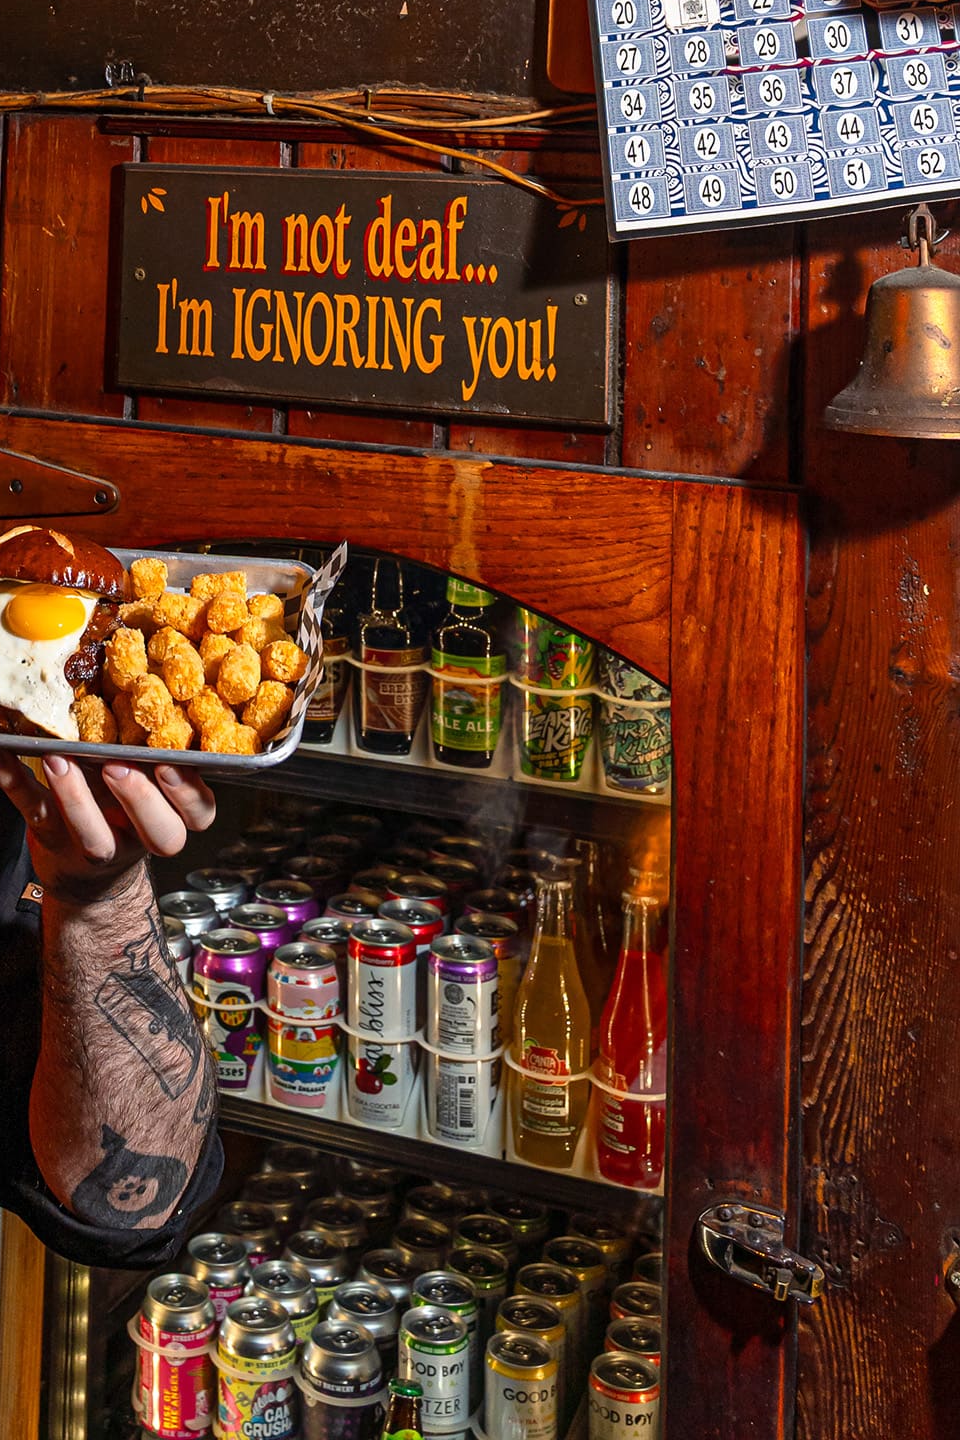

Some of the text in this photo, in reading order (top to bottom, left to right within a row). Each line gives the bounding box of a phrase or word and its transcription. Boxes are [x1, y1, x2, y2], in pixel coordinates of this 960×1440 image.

[614, 0, 634, 25] 20
[827, 25, 848, 50] 30
[899, 15, 919, 41] 31
[687, 40, 708, 64] 28
[757, 33, 777, 57] 29
[620, 47, 638, 71] 27
[834, 71, 853, 95] 37
[906, 62, 928, 87] 38
[693, 85, 713, 110] 35
[762, 78, 783, 103] 36
[624, 93, 643, 117] 34
[840, 116, 861, 140] 44
[913, 107, 935, 131] 45
[697, 131, 717, 155] 42
[768, 124, 788, 148] 43
[627, 139, 645, 162] 41
[846, 162, 866, 187] 51
[920, 152, 941, 177] 52
[701, 178, 722, 203] 49
[774, 170, 794, 195] 50
[631, 185, 652, 211] 48
[204, 190, 499, 284] I'm not deaf...
[155, 277, 559, 402] I'm IGNORING you!
[466, 720, 495, 733] ALE
[503, 1387, 549, 1404] GOOD
[625, 1412, 654, 1427] BOY
